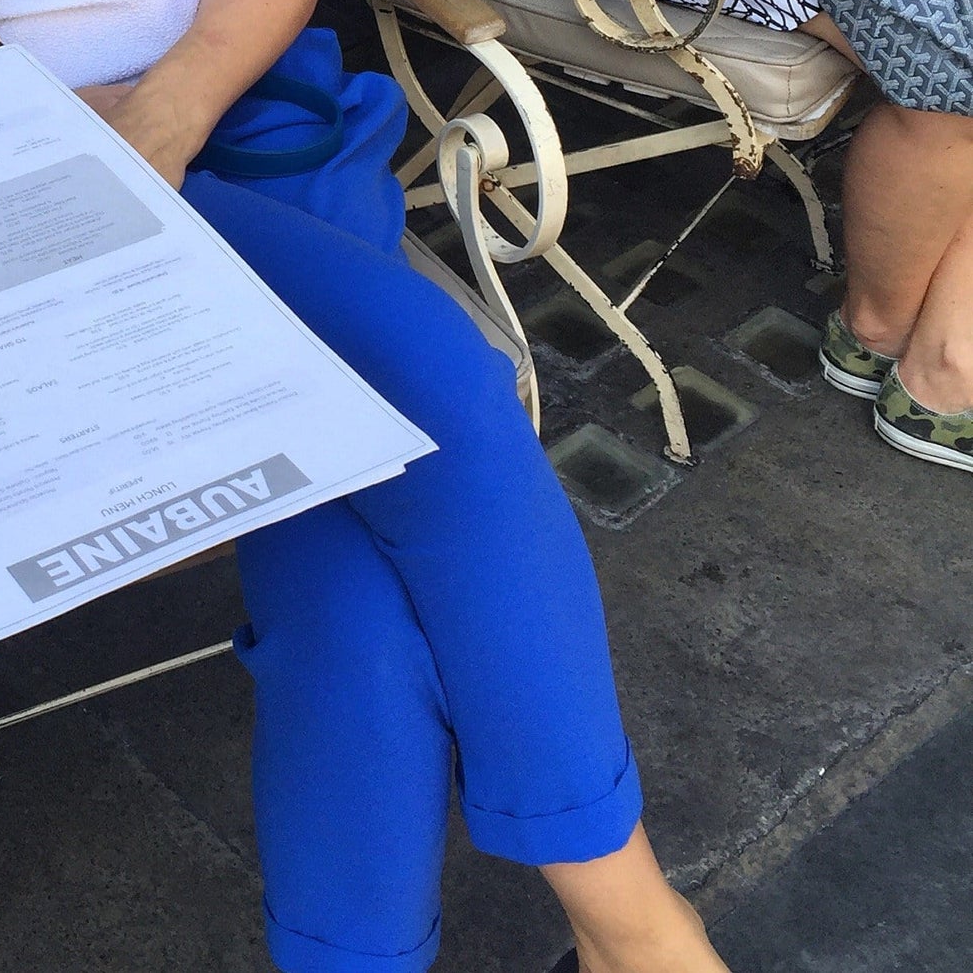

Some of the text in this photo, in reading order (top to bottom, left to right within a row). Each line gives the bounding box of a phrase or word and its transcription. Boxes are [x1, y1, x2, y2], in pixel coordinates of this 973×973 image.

[57, 423, 100, 443] STARTERS
[99, 480, 177, 517] LUNCH MENU
[105, 475, 145, 495] APERITIF
[37, 468, 273, 587] AUBAINE
